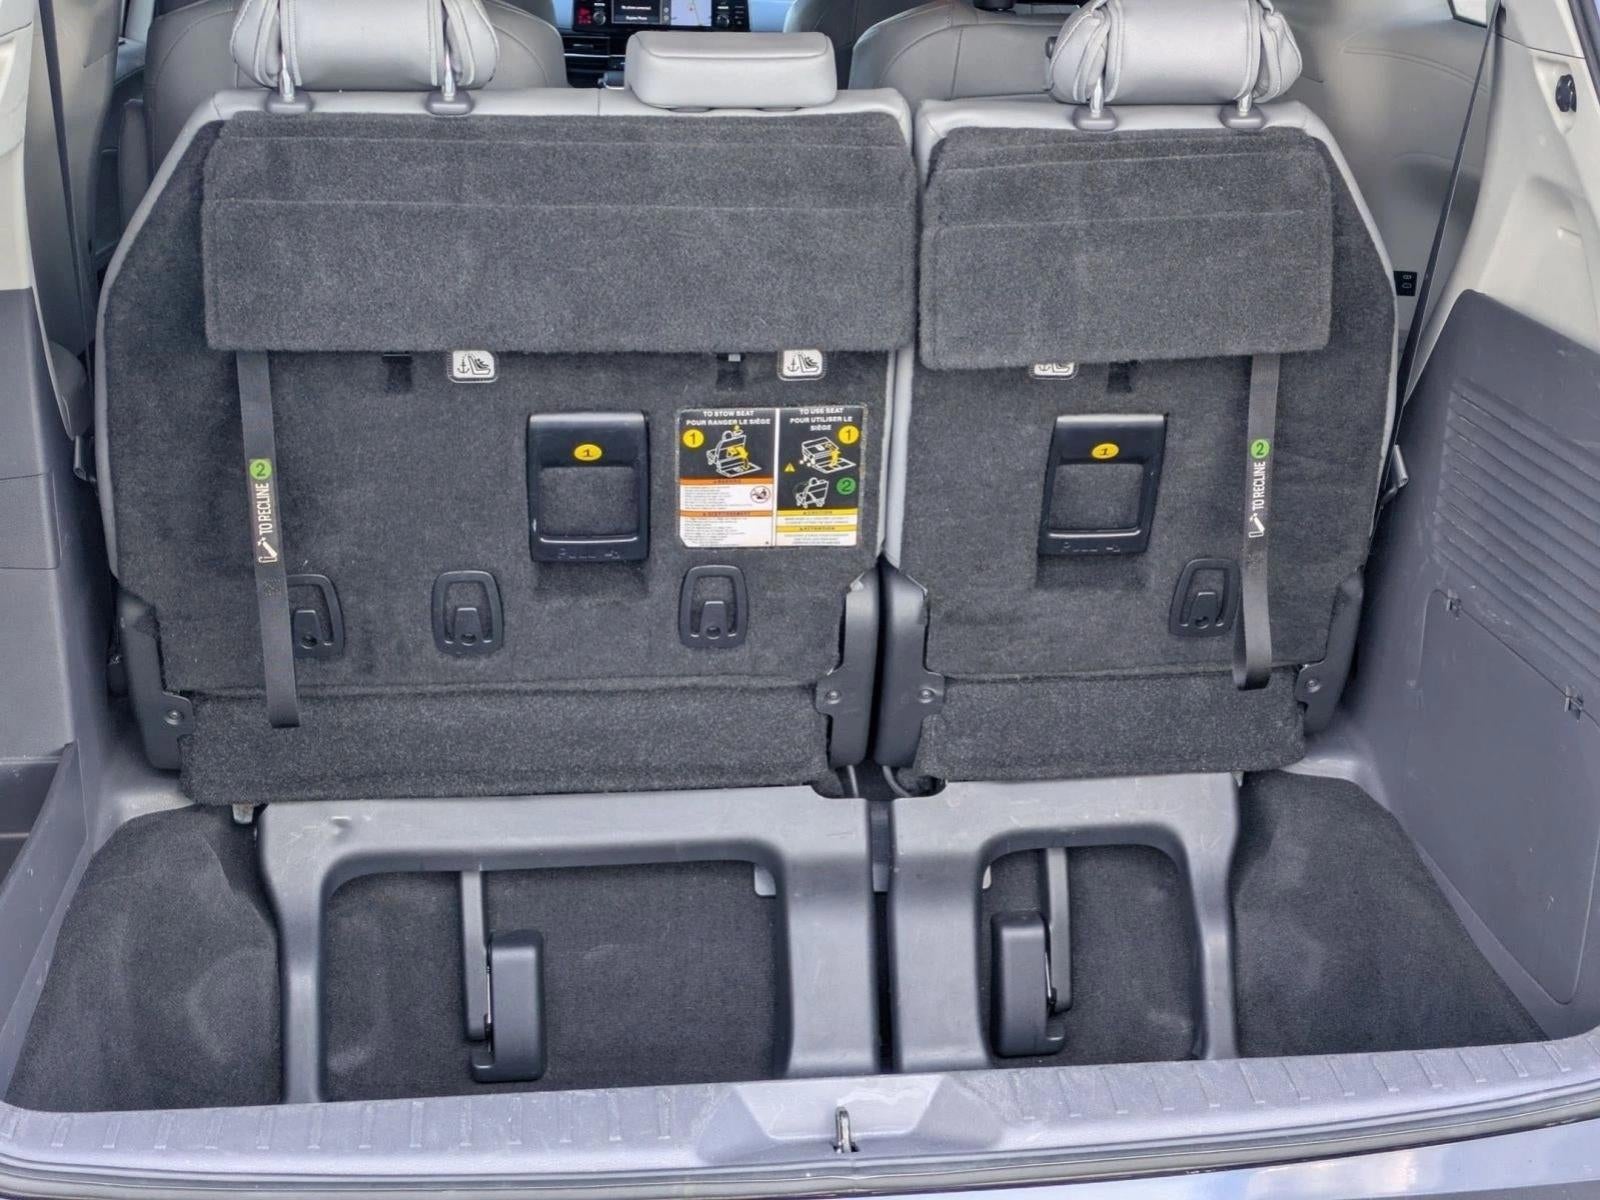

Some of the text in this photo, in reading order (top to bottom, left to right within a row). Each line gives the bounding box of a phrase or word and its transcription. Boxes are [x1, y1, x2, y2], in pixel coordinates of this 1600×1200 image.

[255, 483, 273, 536] TO RECLINE
[1252, 461, 1266, 511] TO RECLINE
